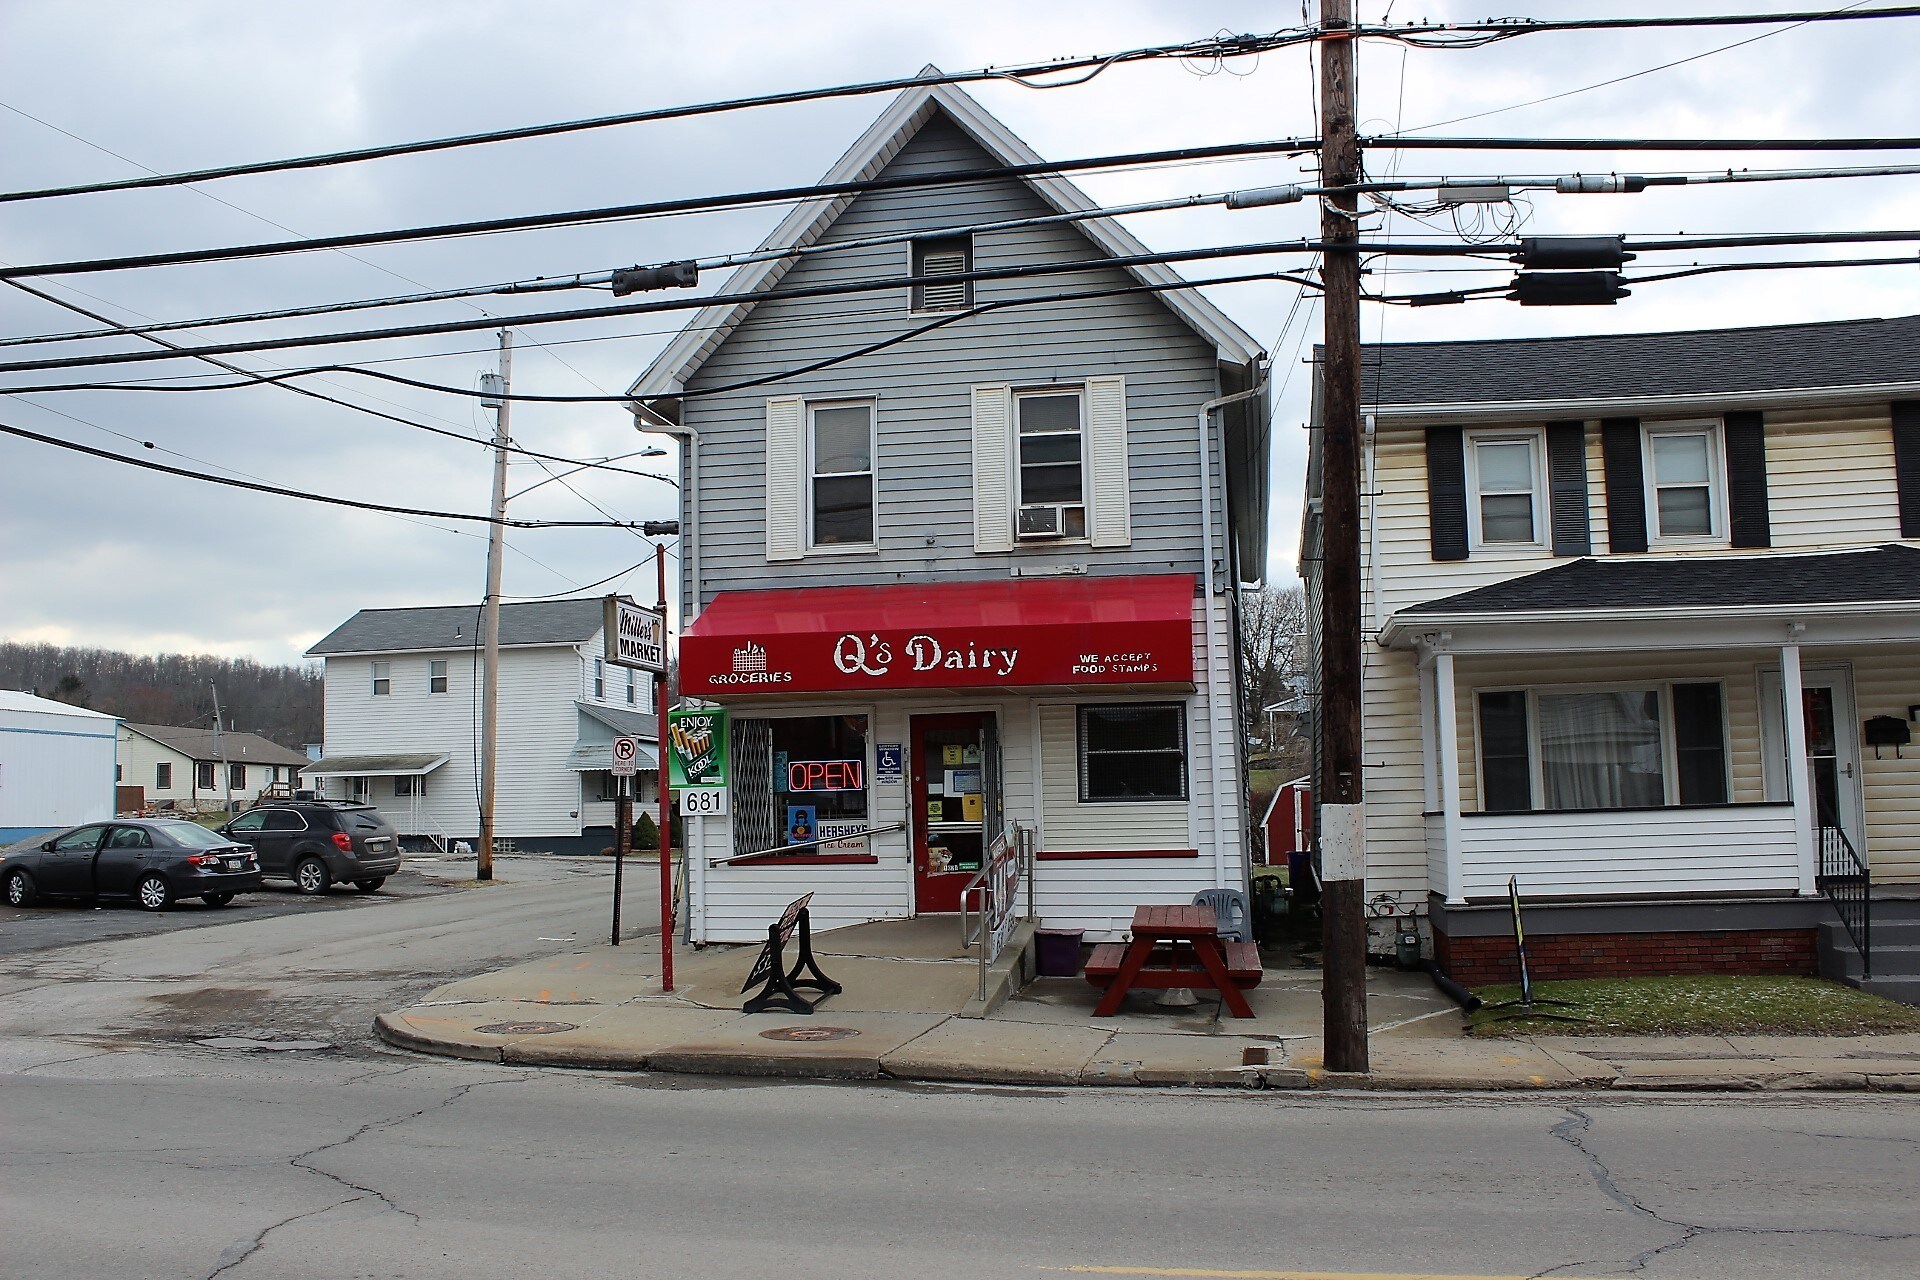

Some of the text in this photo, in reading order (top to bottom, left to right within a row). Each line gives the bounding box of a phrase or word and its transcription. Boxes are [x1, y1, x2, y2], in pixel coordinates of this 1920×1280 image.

[619, 607, 652, 640] Miller's
[619, 637, 661, 664] MARKET
[833, 633, 1018, 676] Q's Dairy
[1079, 652, 1151, 663] WE ACCEPT
[1072, 663, 1158, 674] FOOD STAMPS
[708, 671, 793, 685] GROCERIES
[680, 716, 713, 730] ENJOY.
[687, 755, 713, 778] KOOL
[790, 761, 860, 790] OPEN
[837, 840, 865, 849] Cream
